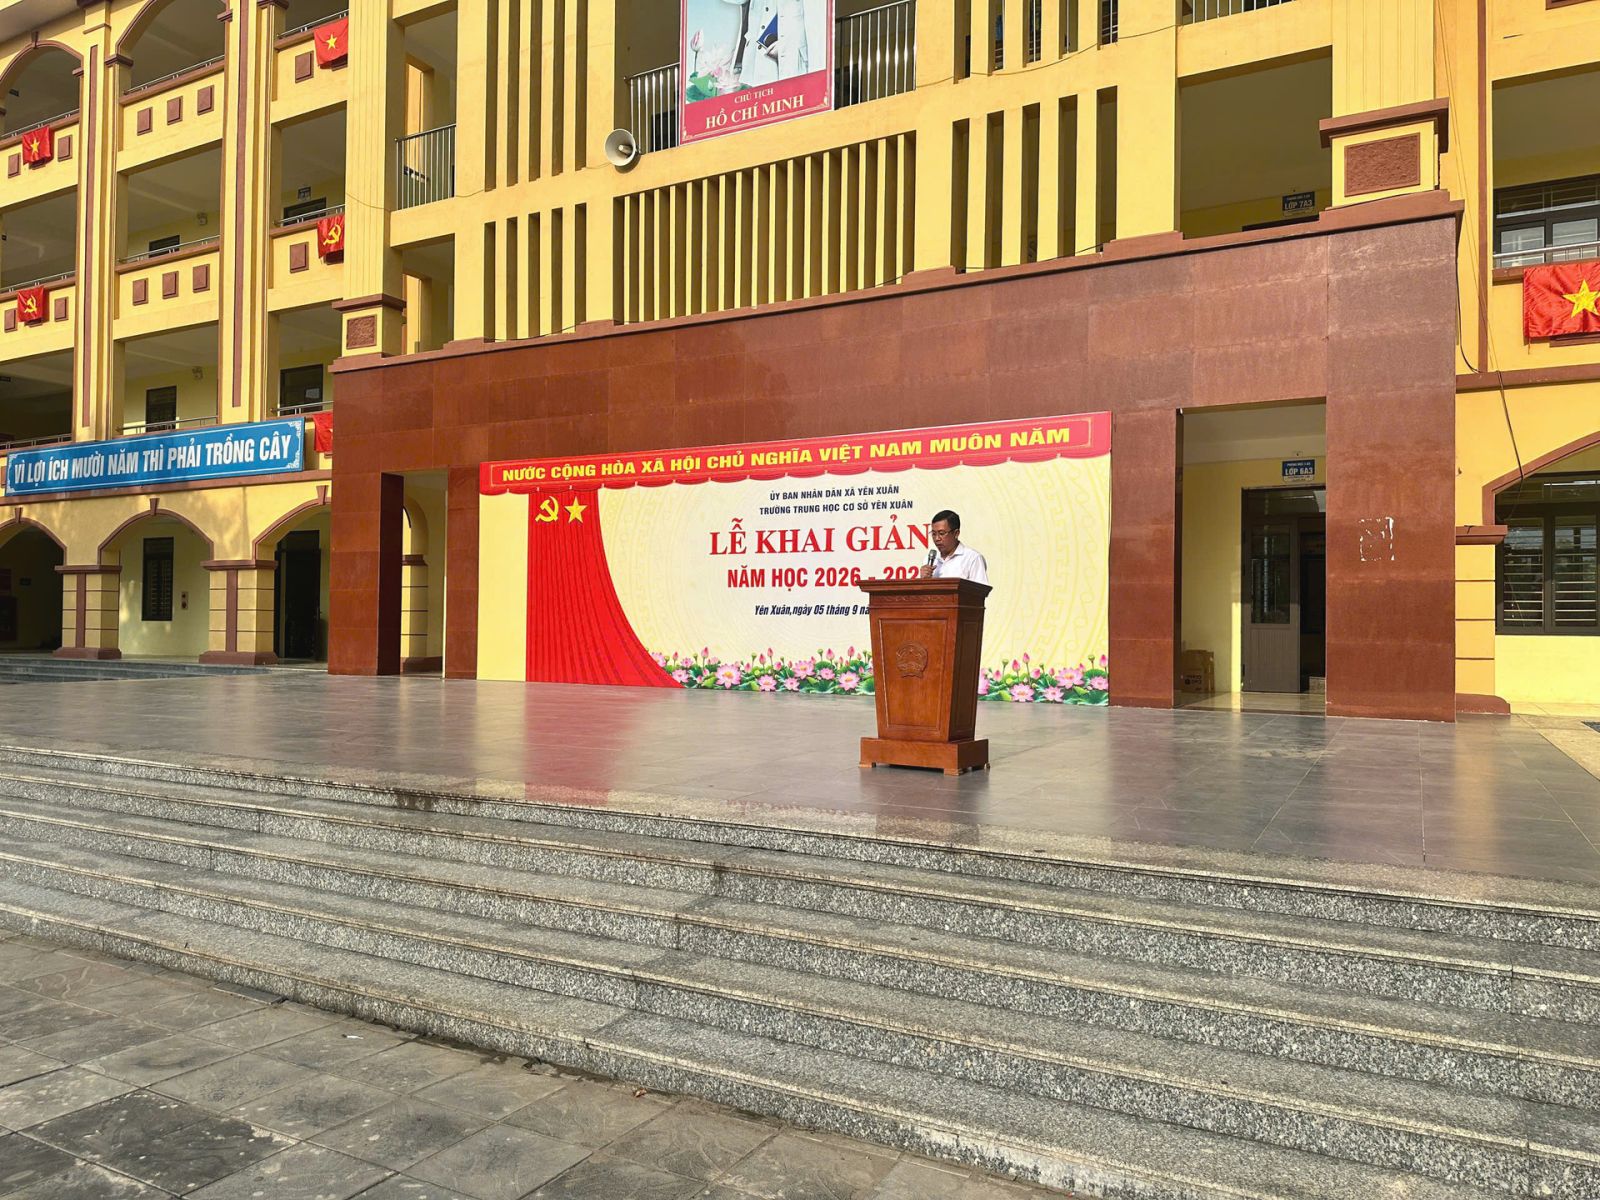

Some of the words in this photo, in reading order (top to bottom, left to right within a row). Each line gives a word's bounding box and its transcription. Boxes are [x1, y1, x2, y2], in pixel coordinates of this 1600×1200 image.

[734, 91, 752, 104] CHỦ
[752, 88, 774, 99] TỊCH
[705, 108, 728, 129] HỒ
[731, 102, 758, 123] CHÍ
[762, 94, 804, 116] MINH
[14, 461, 25, 484] VÌ
[27, 460, 45, 487] LỢI
[48, 453, 69, 480] ÍCH
[71, 452, 104, 478] MƯỜI
[107, 448, 139, 475] NĂM
[142, 444, 164, 472] THÌ
[167, 436, 201, 470] PHẢI
[205, 432, 255, 466] TRỒNG
[259, 431, 292, 461] CÂY
[502, 466, 546, 482] NƯỚC
[550, 463, 596, 481] CỘNG
[601, 459, 636, 476] HÒA
[641, 457, 665, 473] XÃ
[670, 455, 701, 473] HỘI
[706, 450, 745, 468] CHỦ
[751, 447, 813, 466] NGHĨA
[819, 442, 863, 463] VIỆT
[869, 440, 922, 458] NAM
[929, 433, 1002, 453] MUÔN
[1010, 427, 1070, 447] NĂM
[770, 490, 780, 500] ỦY
[783, 491, 798, 500] BAN
[801, 488, 823, 499] NHÂN
[825, 487, 842, 498] DÂN
[845, 486, 855, 496] XÃ
[858, 485, 874, 495] YÊN
[876, 484, 899, 494] XUÂN
[759, 504, 791, 515] TRƯỜNG
[793, 504, 820, 514] TRUNG
[822, 503, 840, 514] HỌC
[843, 502, 855, 511] CƠ
[857, 499, 868, 510] SỞ
[871, 499, 887, 509] YÊN
[889, 498, 913, 509] XUÂN
[709, 517, 747, 556] LỄ
[755, 527, 835, 554] KHAI
[846, 514, 932, 552] GIẢN
[728, 565, 765, 588] NĂM
[771, 567, 808, 592] HỌC
[815, 566, 861, 588] 2026
[883, 565, 919, 581] 202
[755, 604, 769, 616] Yên
[814, 604, 825, 615] 05
[826, 603, 850, 617] tháng
[852, 604, 859, 615] 9
